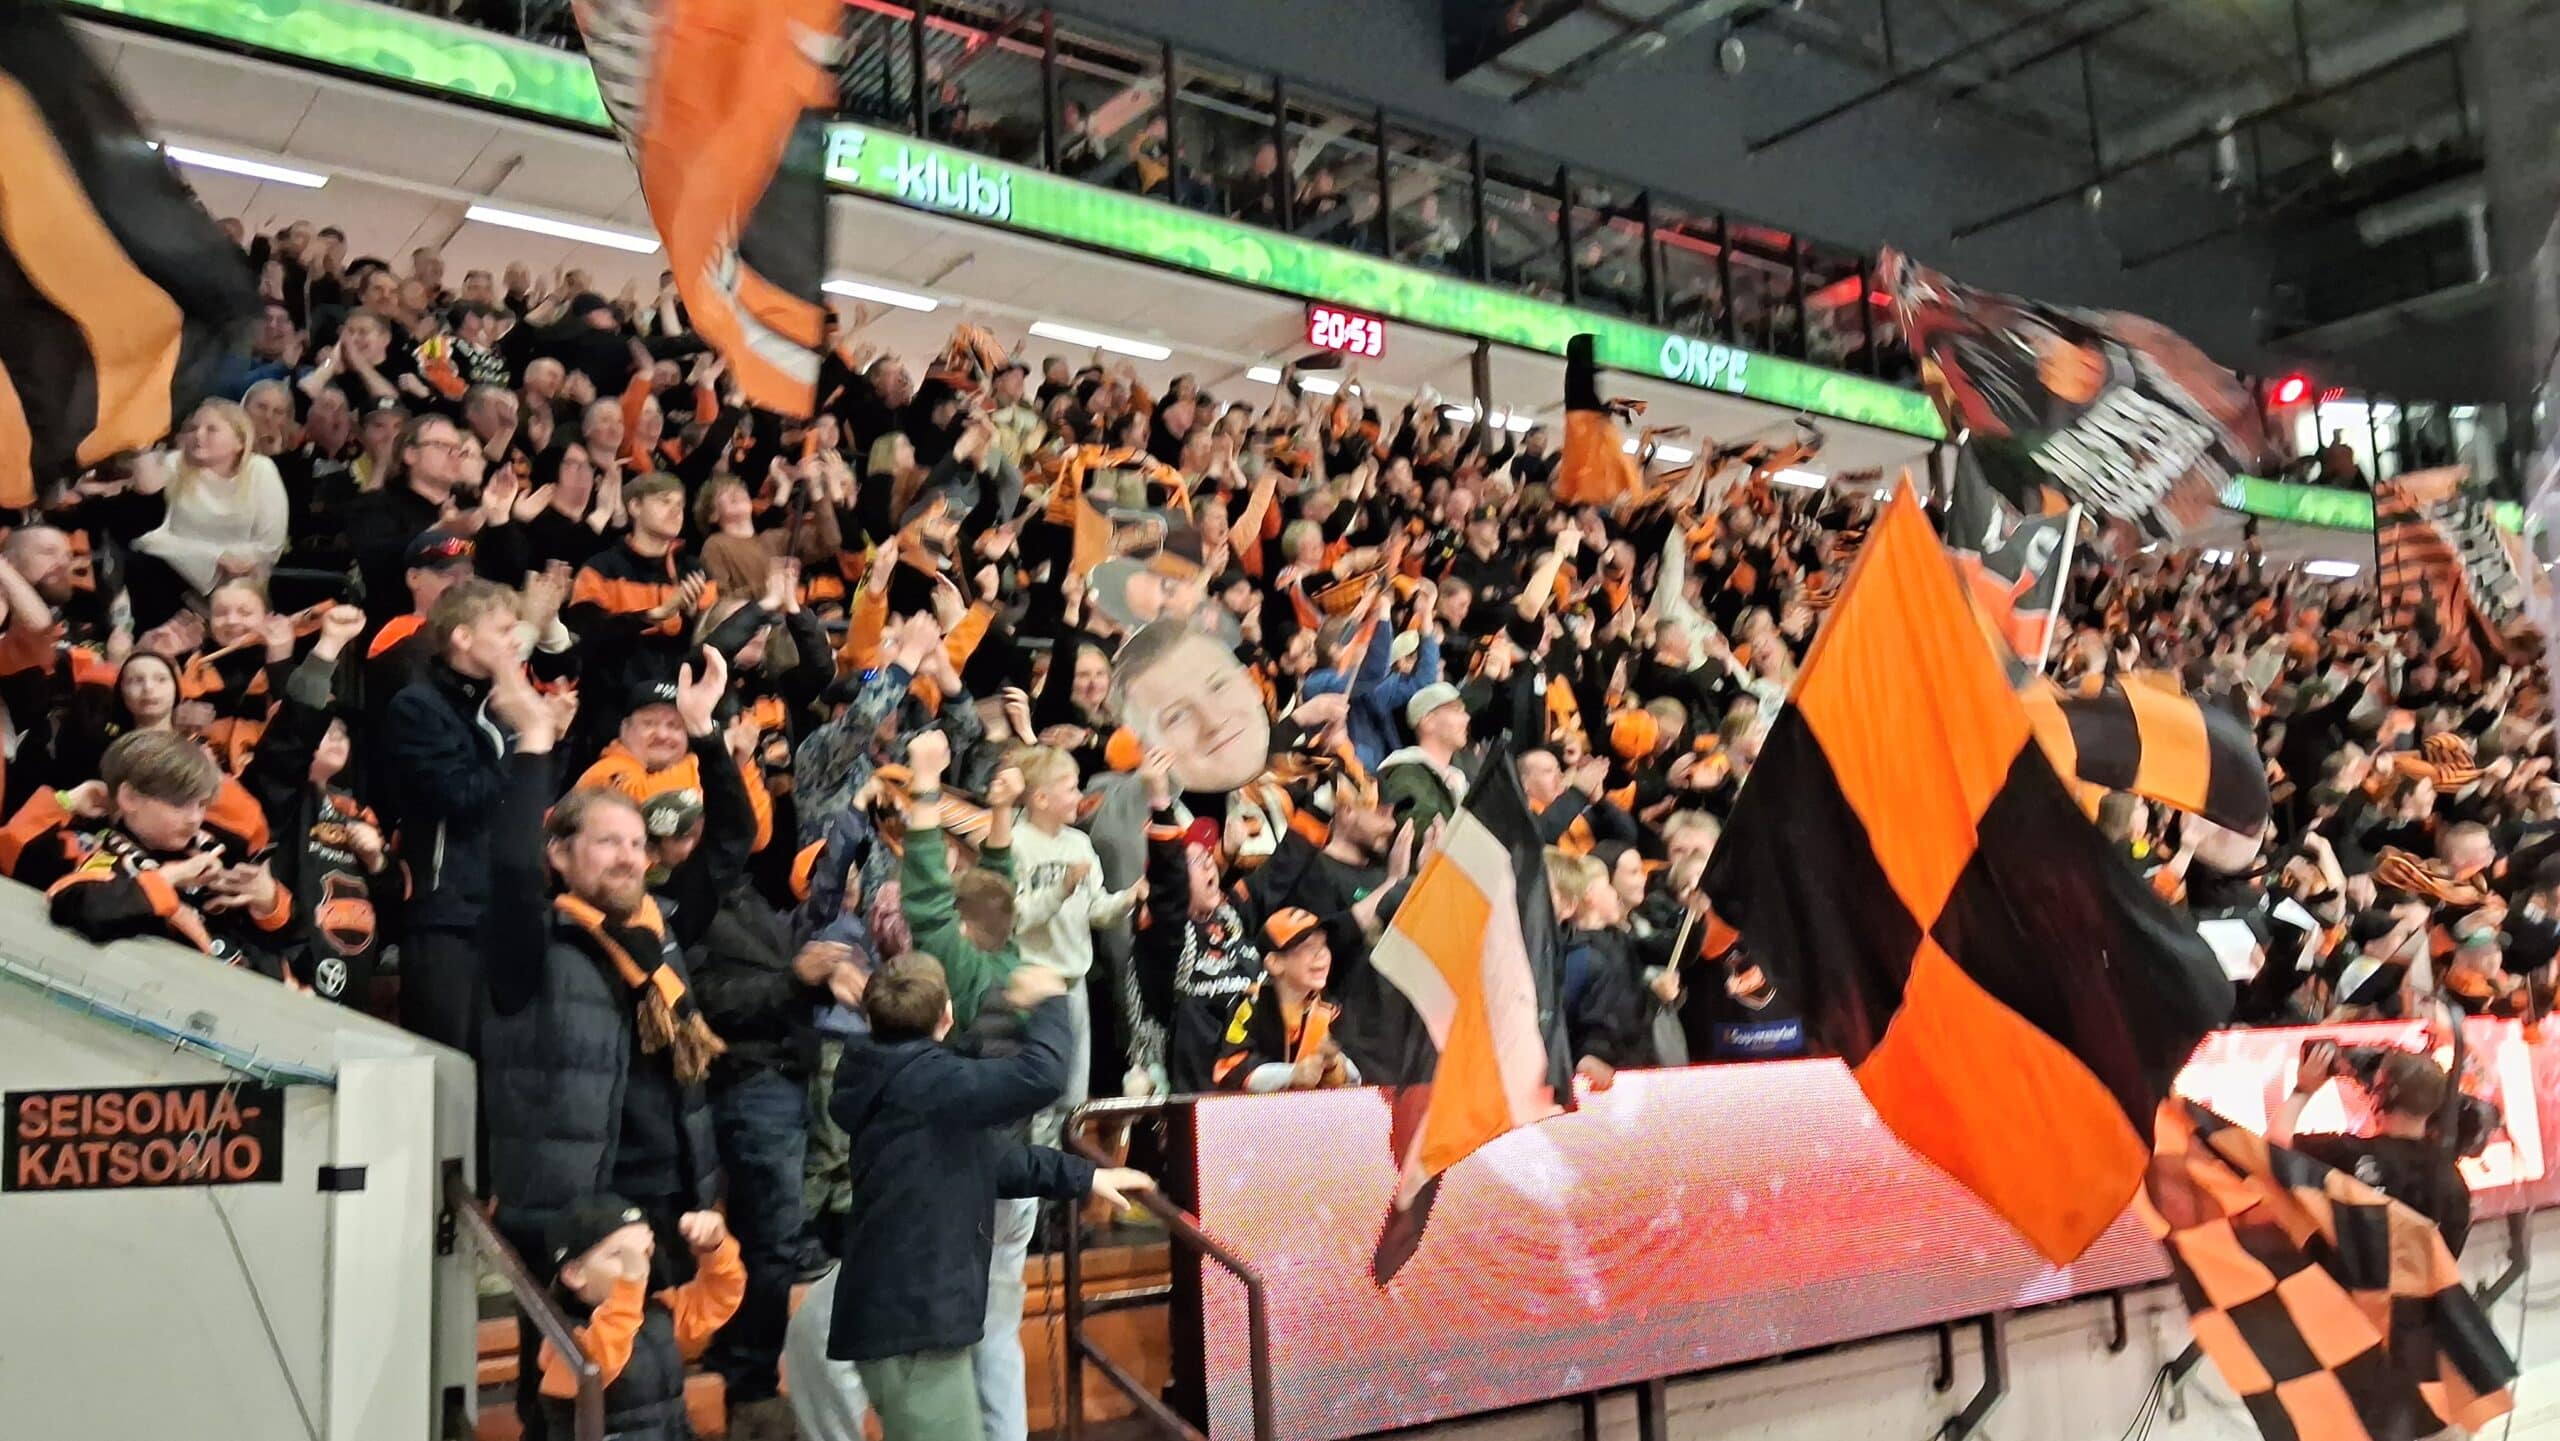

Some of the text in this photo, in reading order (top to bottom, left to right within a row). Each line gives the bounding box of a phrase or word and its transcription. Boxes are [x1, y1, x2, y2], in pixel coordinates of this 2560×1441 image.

[823, 129, 1013, 222] E -klubi
[1660, 334, 1749, 394] ORPE
[17, 1088, 262, 1139] SEISOMA-
[17, 1134, 262, 1187] KATSOMO
